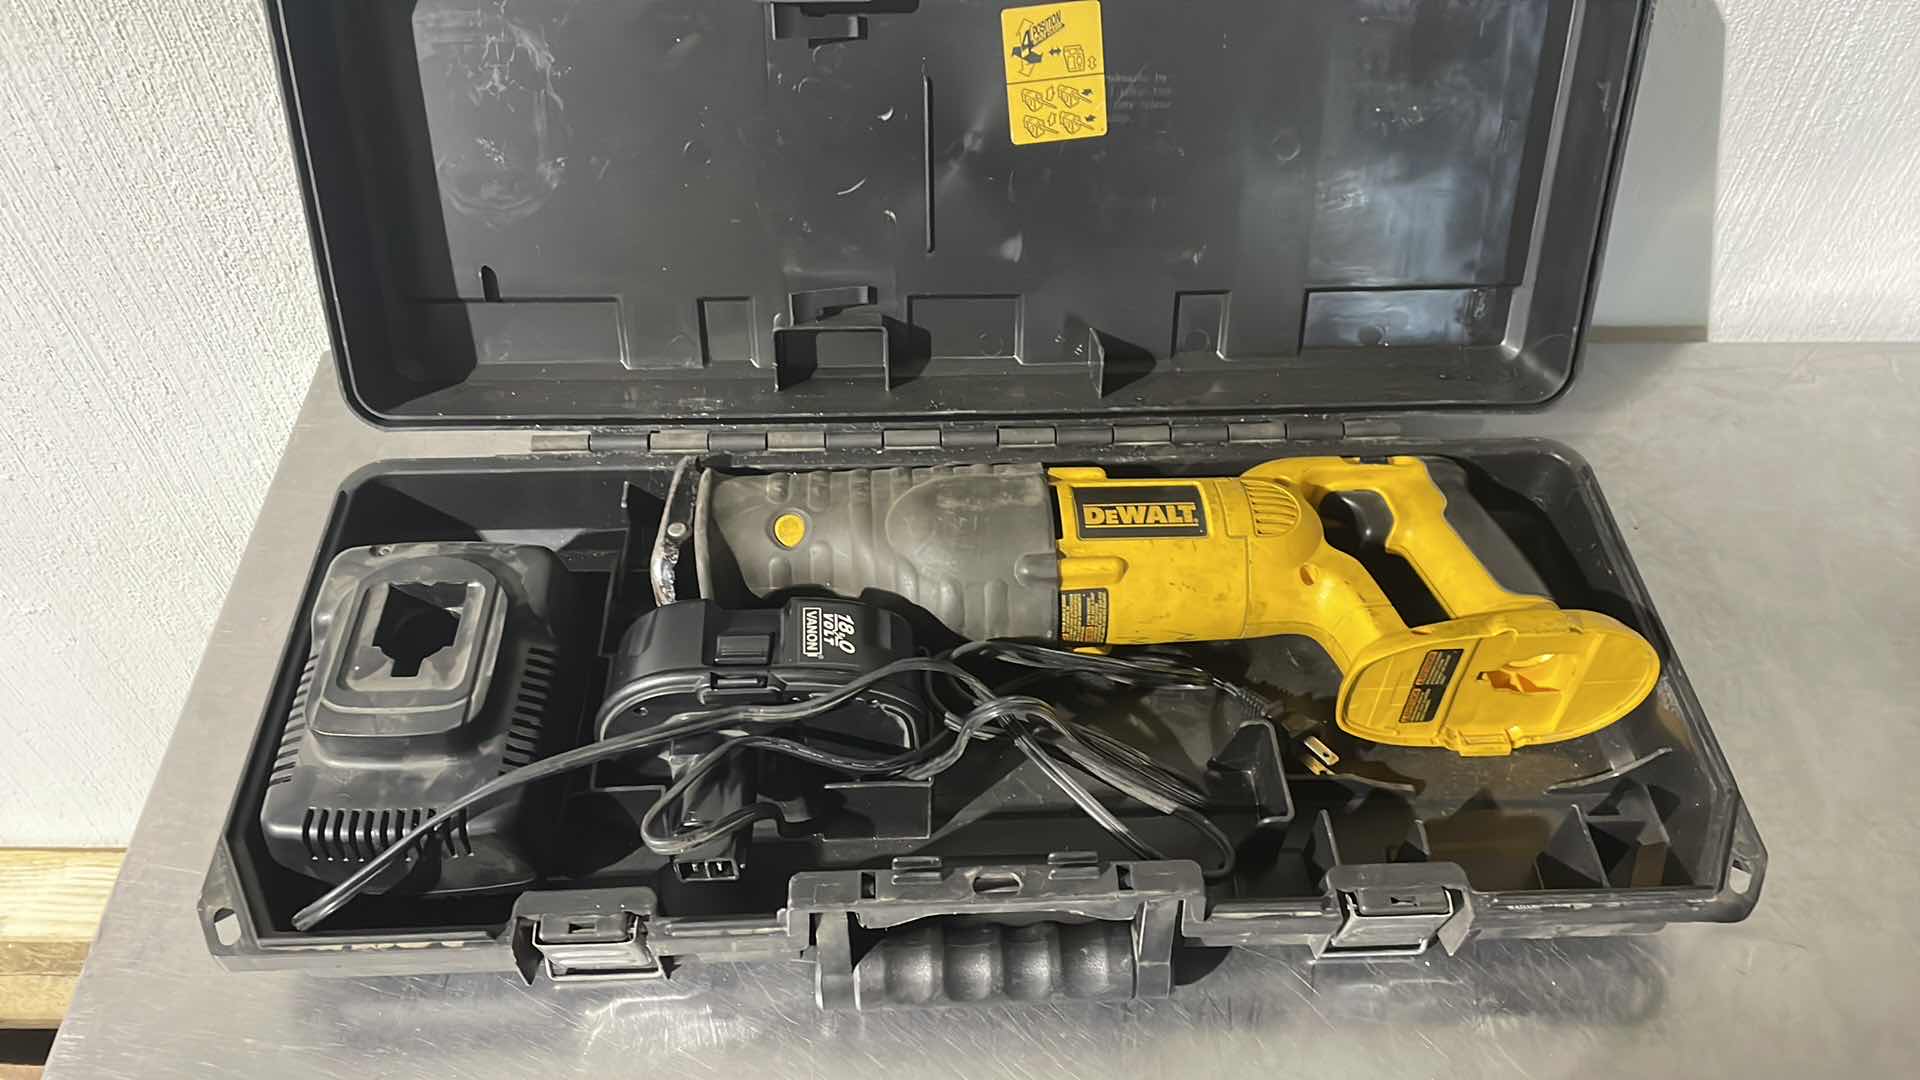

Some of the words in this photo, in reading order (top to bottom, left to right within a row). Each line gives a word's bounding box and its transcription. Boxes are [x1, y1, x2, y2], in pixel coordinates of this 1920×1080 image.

[806, 610, 818, 651] VANON
[823, 613, 835, 646] VOLT
[838, 614, 855, 654] 18.0
